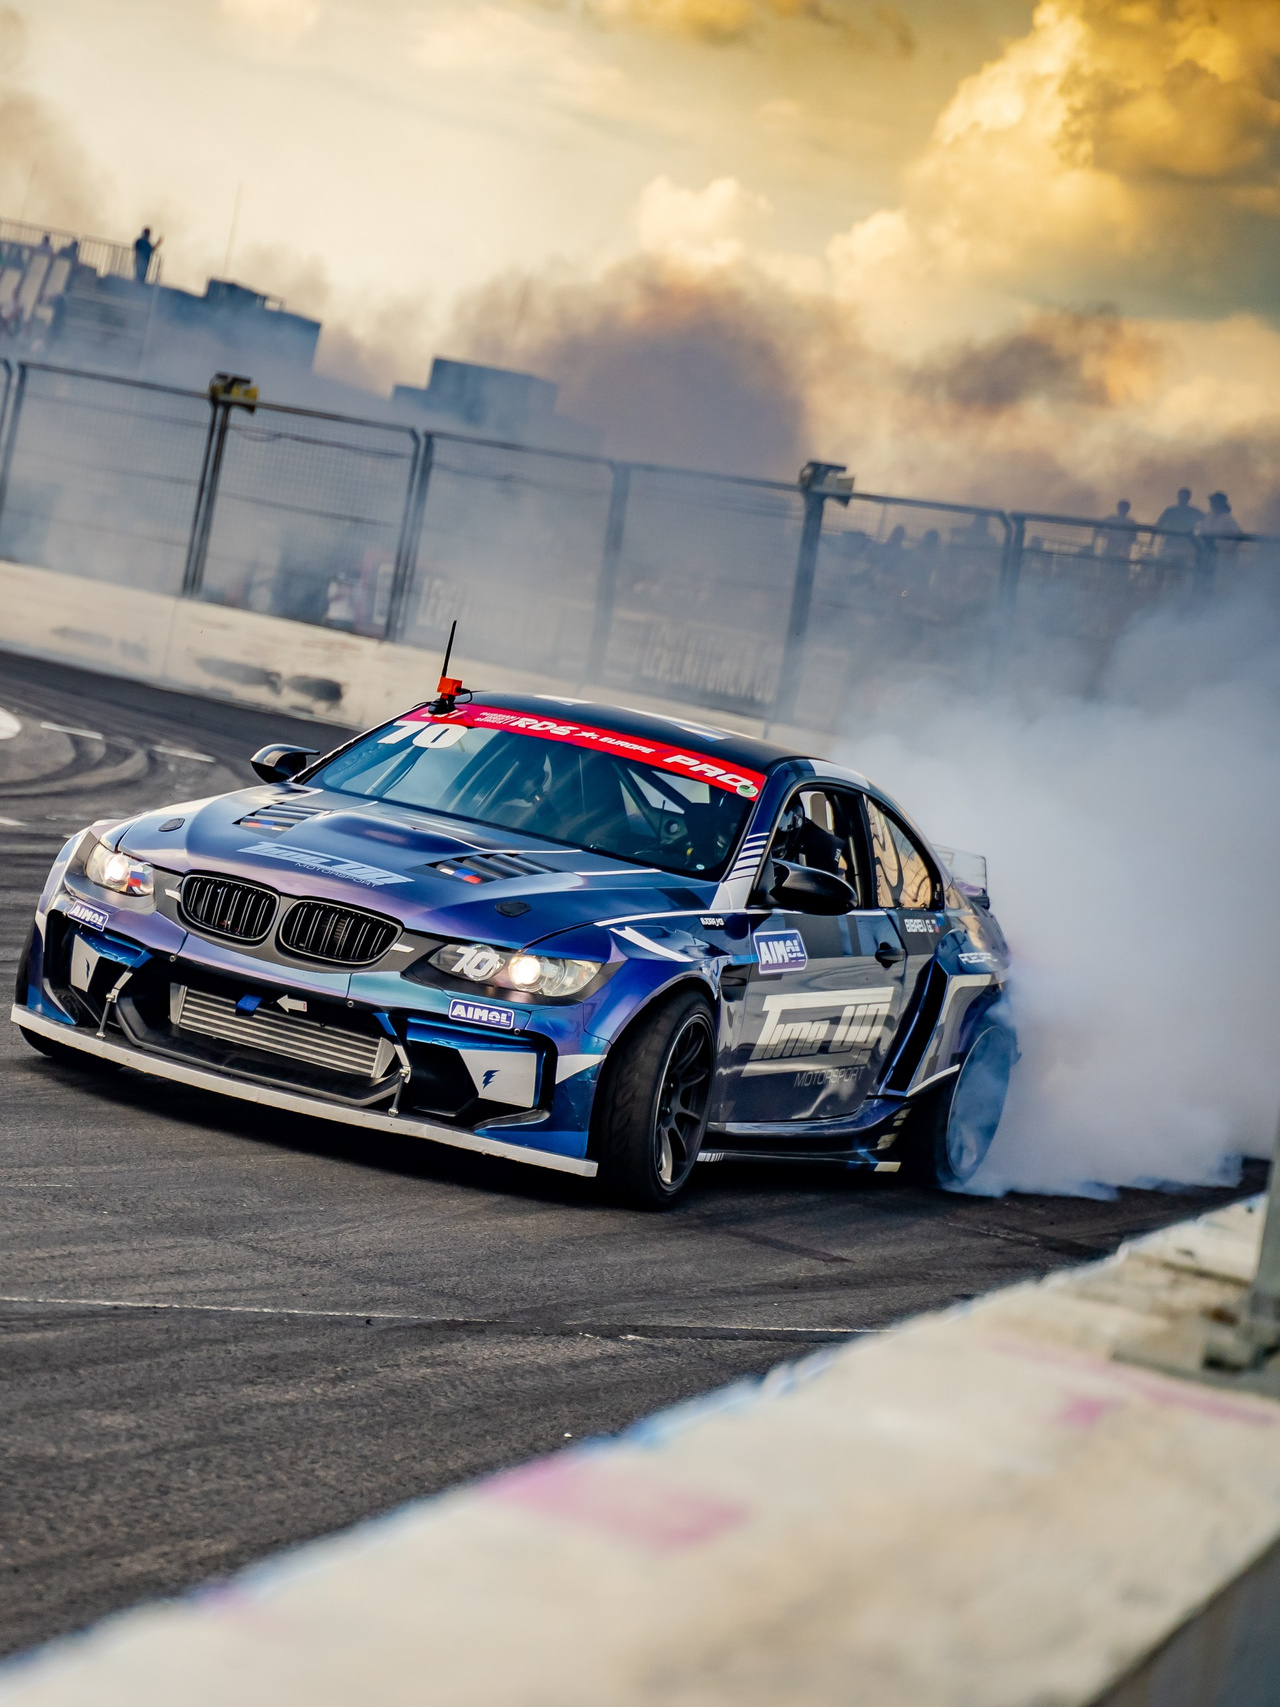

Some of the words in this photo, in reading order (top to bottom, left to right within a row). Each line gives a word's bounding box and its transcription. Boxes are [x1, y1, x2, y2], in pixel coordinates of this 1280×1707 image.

[377, 720, 469, 750] 70
[509, 717, 580, 736] RDS
[599, 736, 656, 755] EUROPE
[662, 754, 754, 788] PRO
[295, 862, 379, 888] MOTORSPORT
[69, 905, 104, 927] AIMOL
[451, 946, 499, 977] 70
[759, 940, 806, 965] AIMOL
[452, 1004, 510, 1025] AIMOL
[793, 1066, 866, 1089] MOTORSPORT
